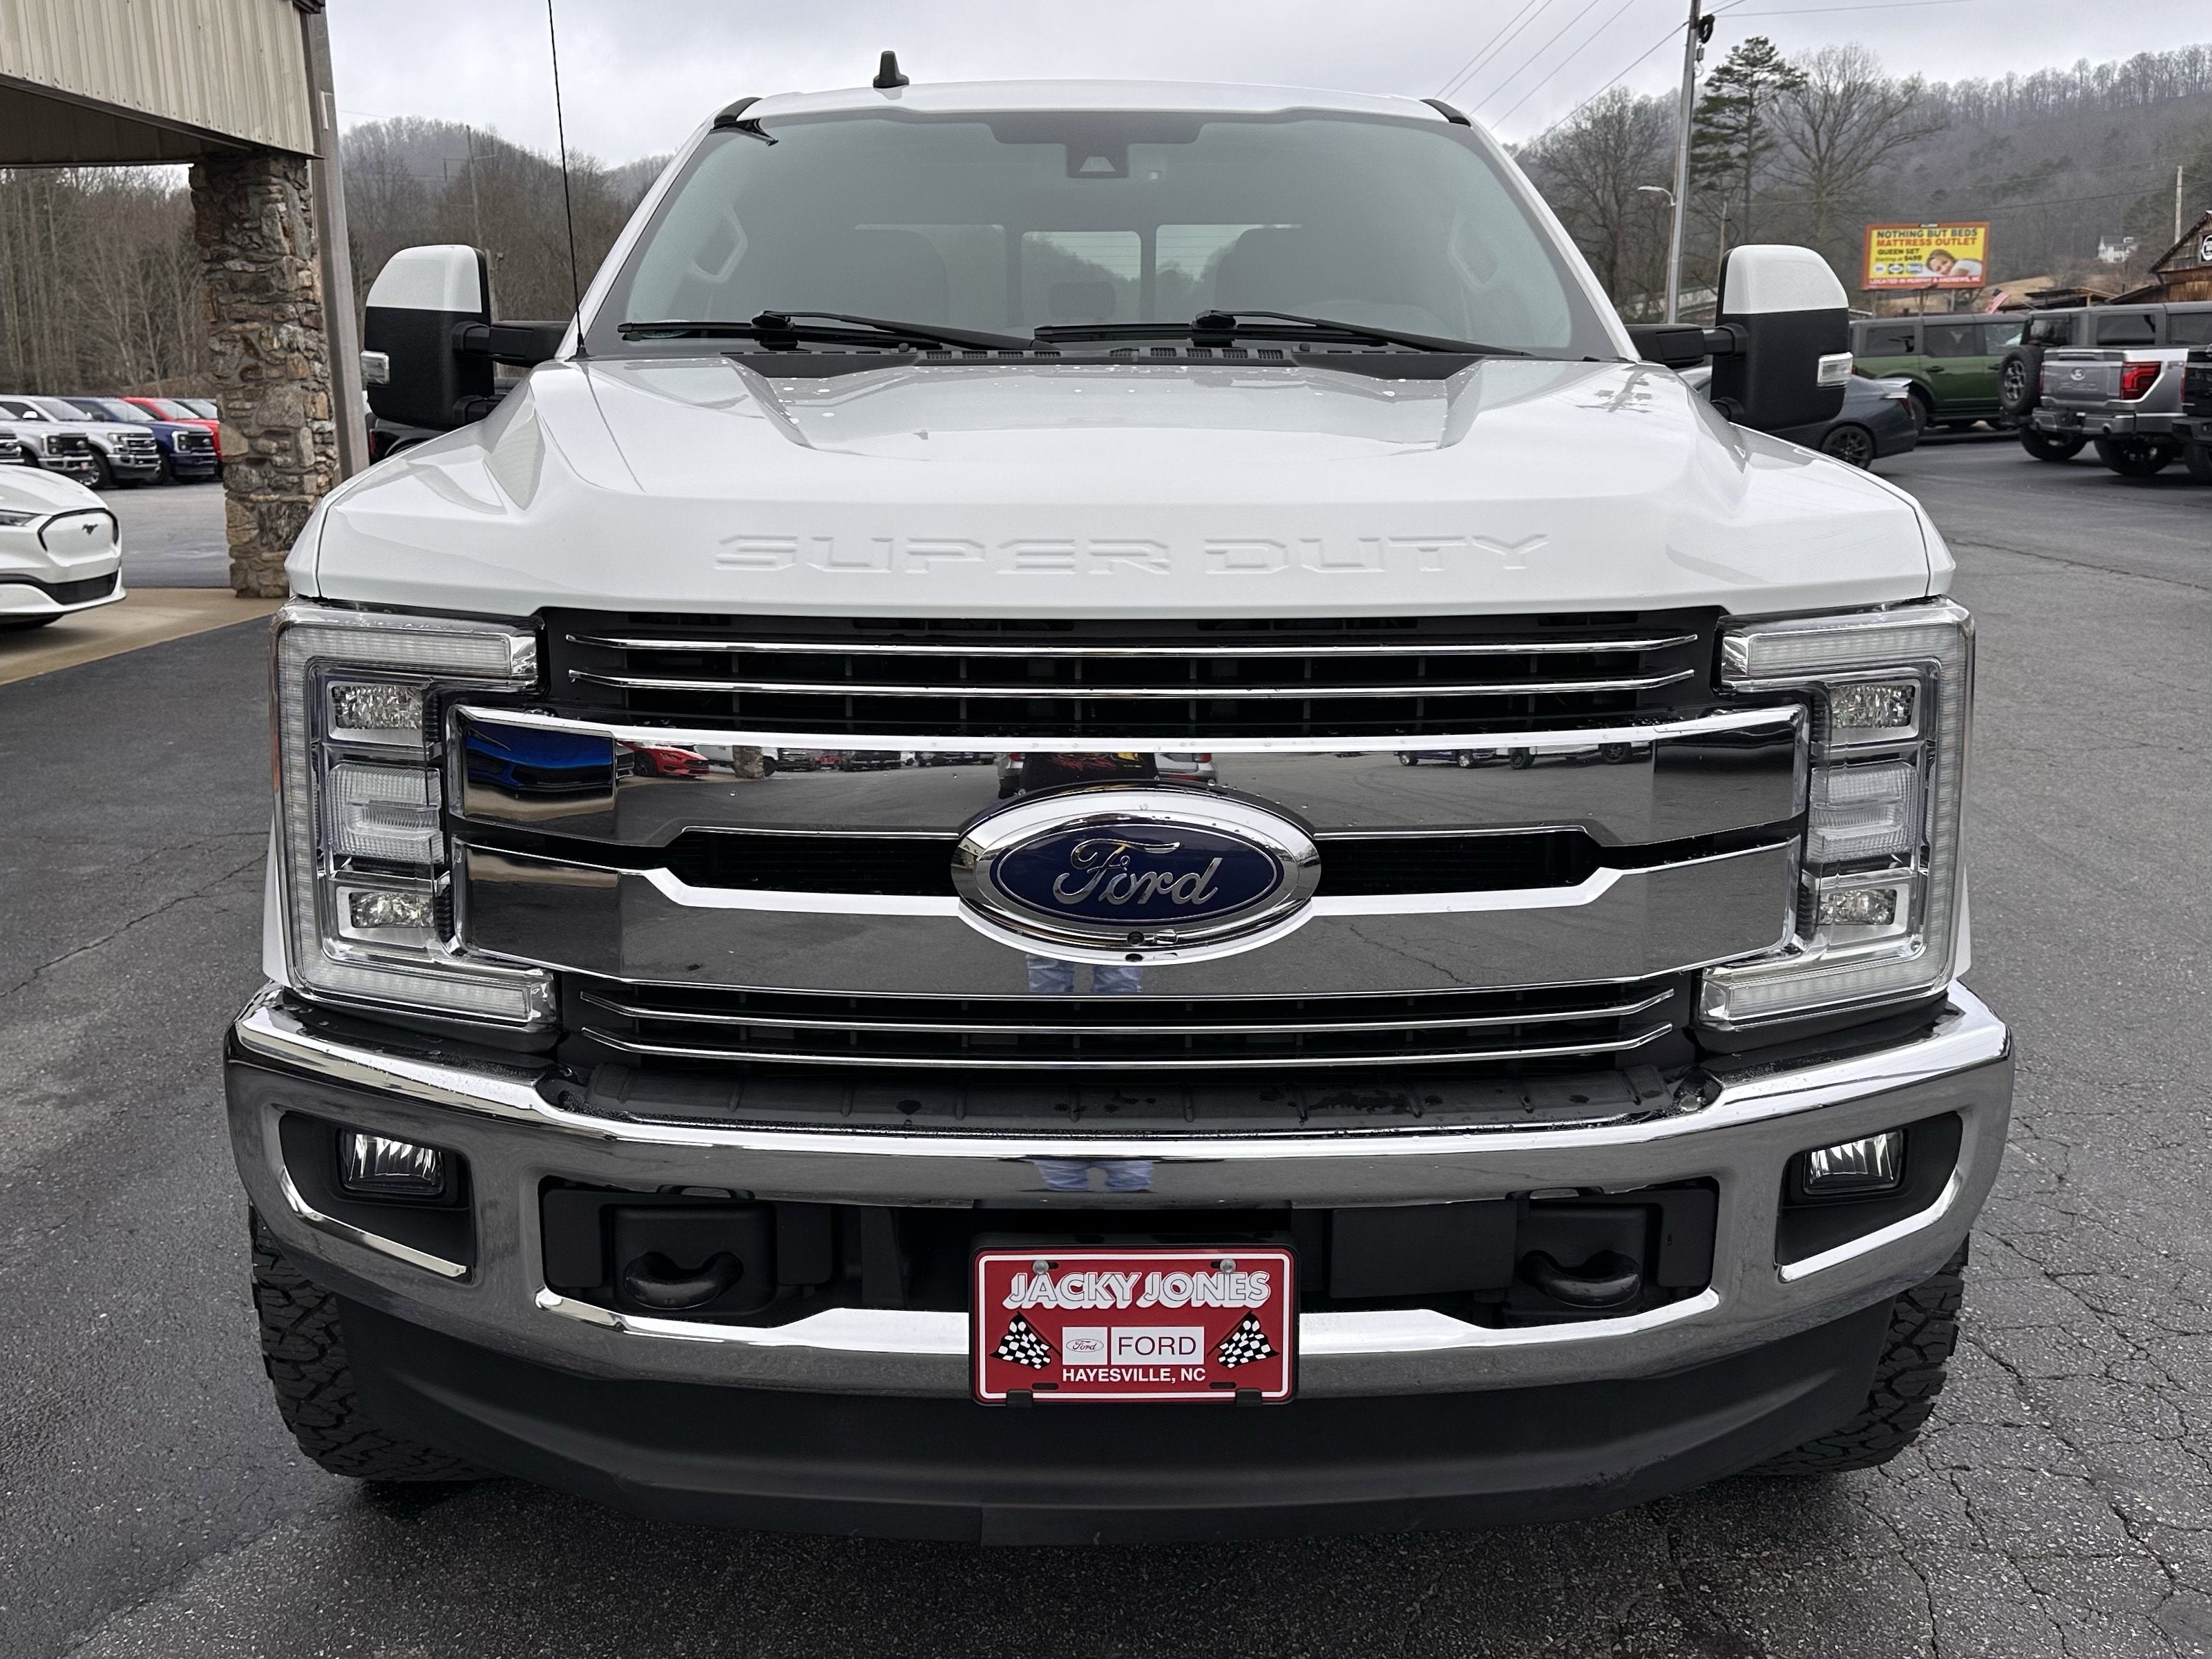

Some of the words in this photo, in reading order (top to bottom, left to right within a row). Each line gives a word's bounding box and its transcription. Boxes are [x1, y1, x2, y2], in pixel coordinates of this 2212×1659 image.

[1877, 230, 1924, 238] NOTHING
[1927, 229, 1947, 238] BUT
[1951, 228, 1978, 237] BEDS
[1876, 238, 1932, 247] MATTRESS
[1935, 238, 1977, 246] OUTLET
[714, 535, 1170, 575] SUPER
[1204, 534, 1550, 575] DUTY
[1053, 838, 1223, 905] Ford
[1003, 1272, 1143, 1310] JACKY
[1136, 1271, 1271, 1309] JONES
[1072, 1337, 1098, 1352] Ford
[1118, 1336, 1196, 1356] FORD
[1062, 1368, 1176, 1383] HAYESVILLE,
[1181, 1368, 1205, 1382] NC
